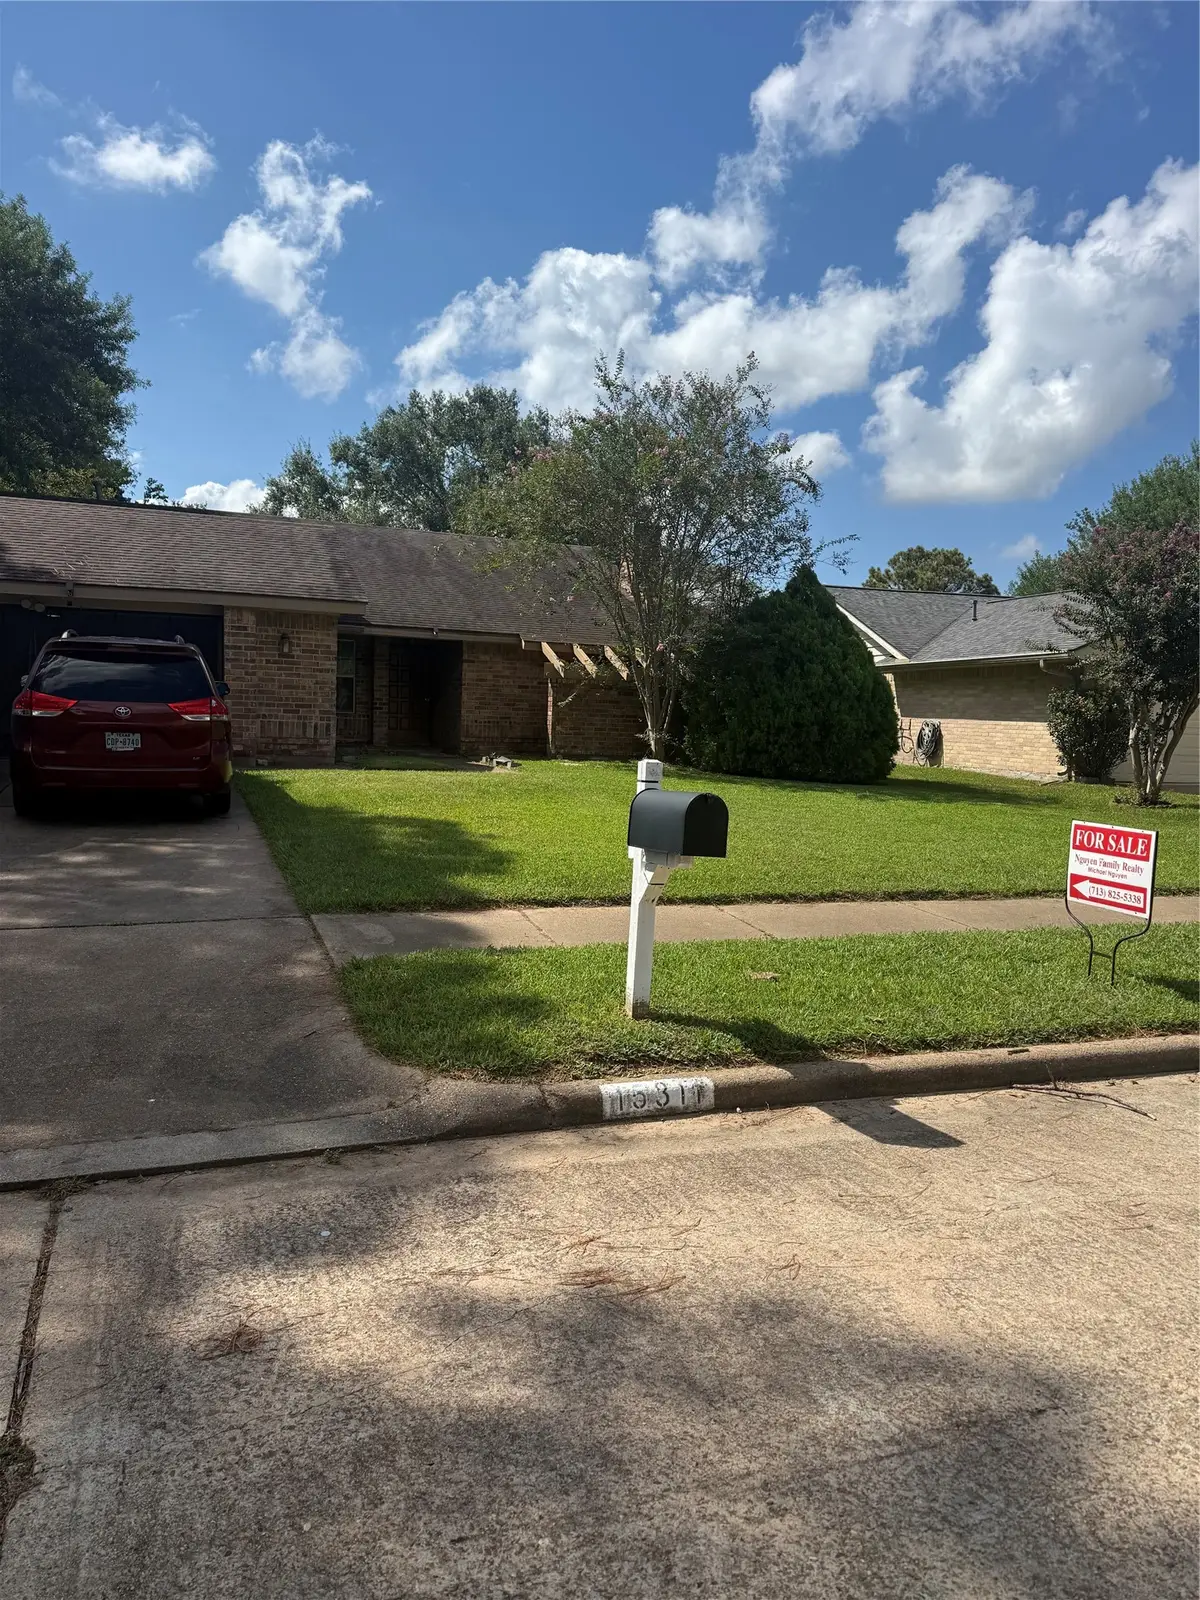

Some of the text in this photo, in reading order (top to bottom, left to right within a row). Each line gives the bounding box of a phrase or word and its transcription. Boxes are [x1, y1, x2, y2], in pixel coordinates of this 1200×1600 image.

[1075, 829, 1148, 856] FOR SALE
[1075, 853, 1145, 876] Nguyen Family Realty
[1088, 867, 1128, 880] Michael Nguyen
[1088, 885, 1142, 904] (713) 825-5338
